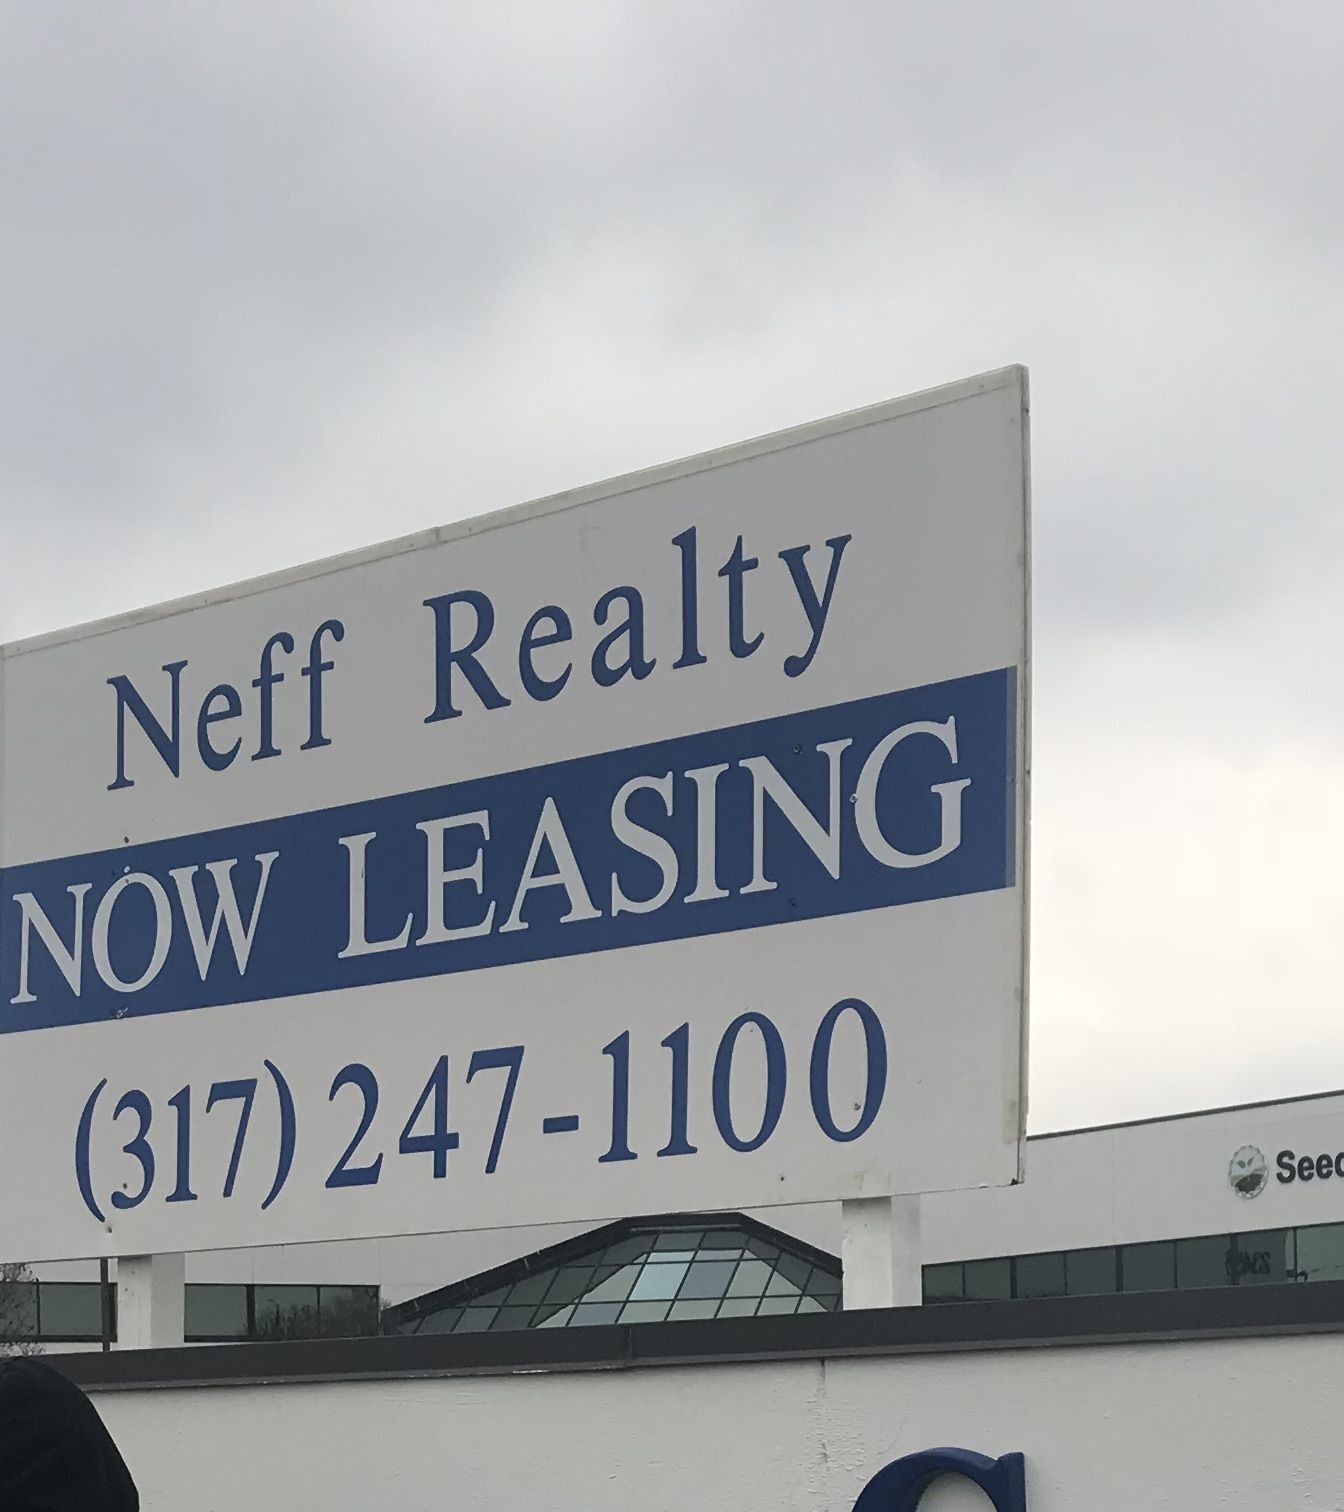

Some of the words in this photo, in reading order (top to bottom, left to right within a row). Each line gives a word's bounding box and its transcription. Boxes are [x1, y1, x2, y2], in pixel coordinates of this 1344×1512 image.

[107, 620, 344, 791] Neff
[422, 526, 852, 724] Realty
[10, 853, 280, 1004] NOW
[337, 716, 972, 960] LEASING
[75, 1060, 296, 1223] (317)
[324, 998, 888, 1189] 247-1100
